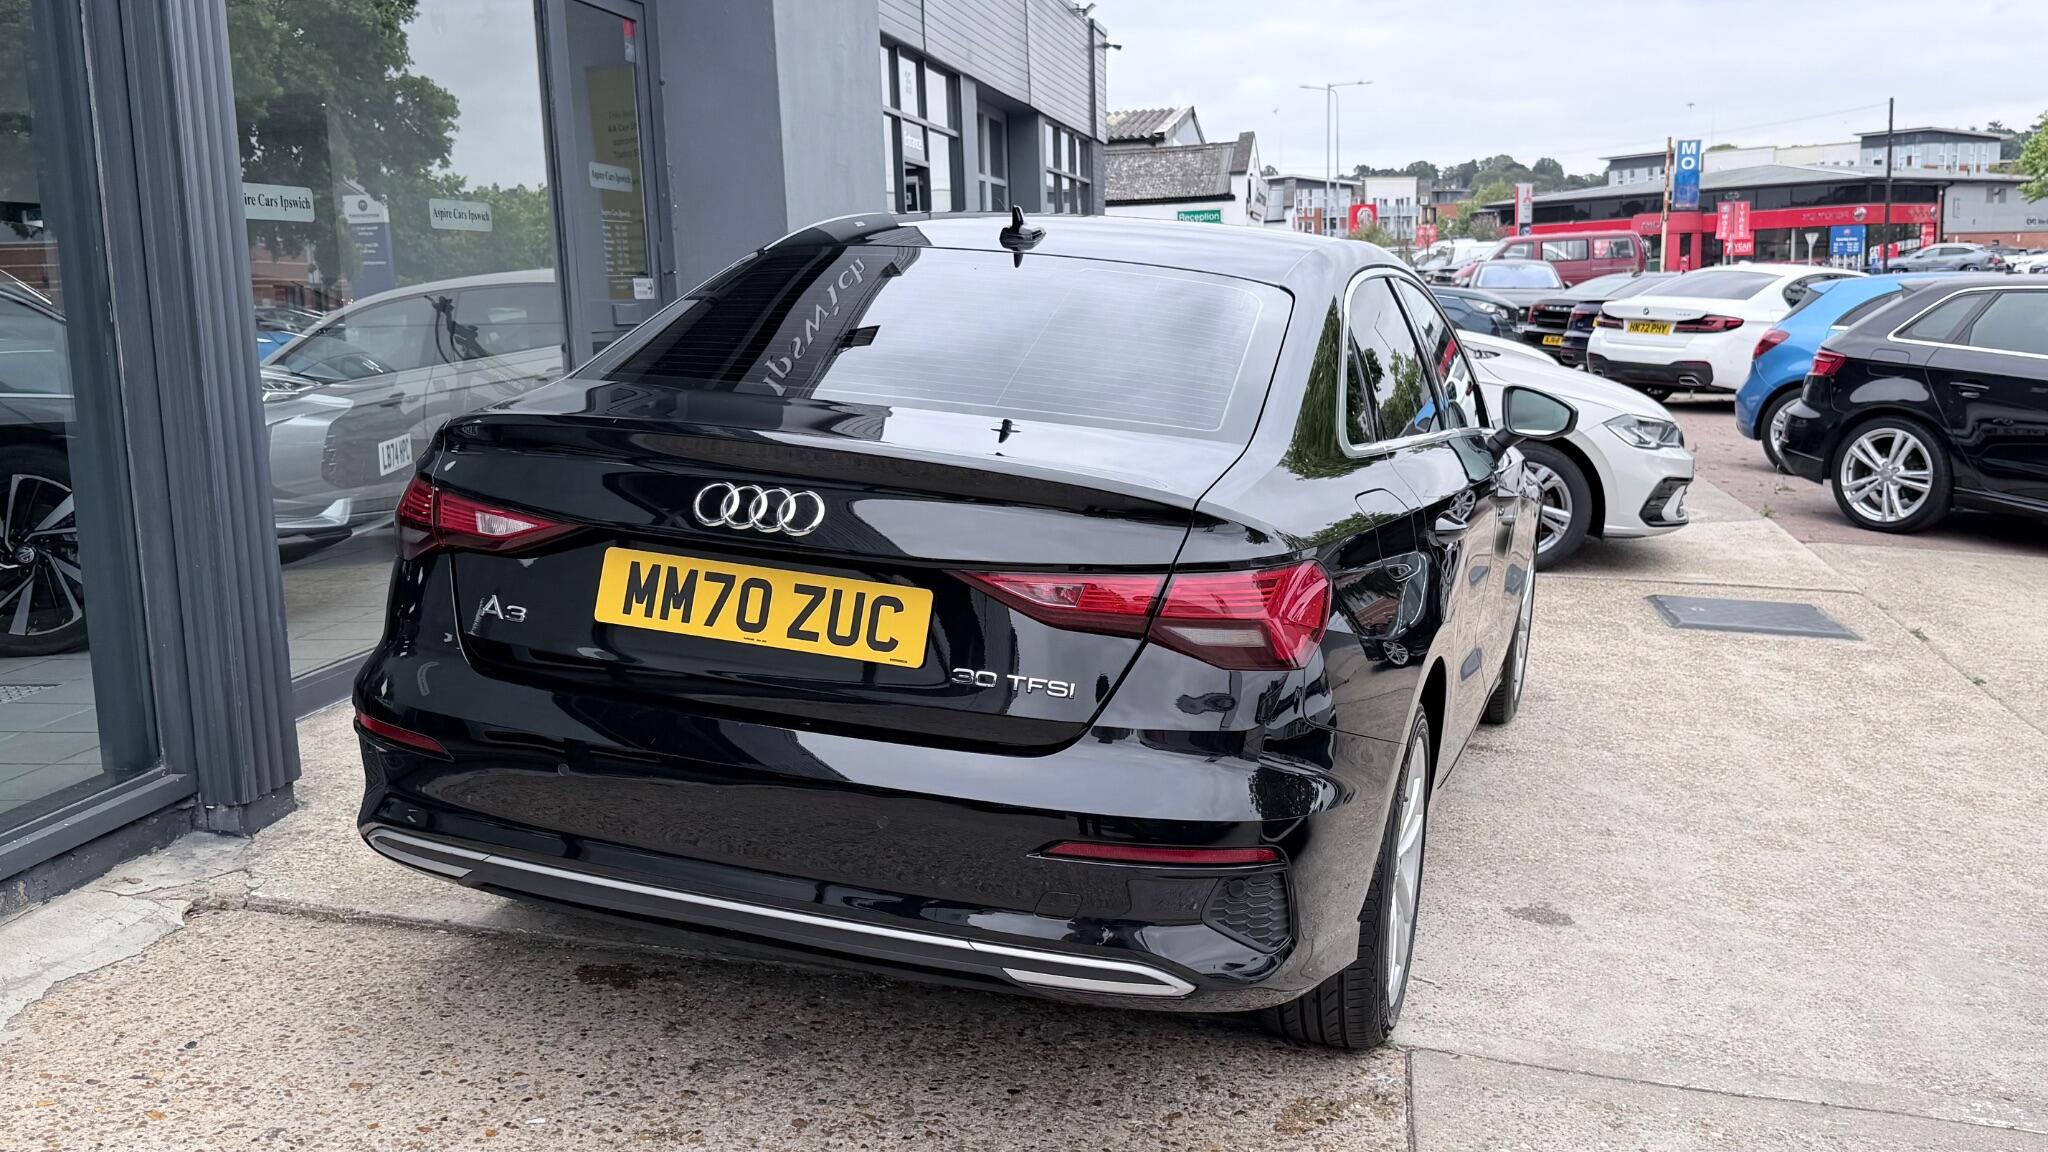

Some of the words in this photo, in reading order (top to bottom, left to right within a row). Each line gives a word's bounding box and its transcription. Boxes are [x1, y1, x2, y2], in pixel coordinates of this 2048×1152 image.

[258, 193, 278, 207] Cars
[280, 195, 311, 211] Ipswich
[433, 207, 452, 220] Aspire
[453, 208, 467, 220] Cars
[468, 209, 490, 223] Ipswich
[1179, 212, 1220, 221] Reception
[481, 594, 527, 622] A3
[622, 560, 773, 633] MM70
[786, 583, 904, 652] ZUC
[952, 667, 997, 688] 30
[1006, 674, 1076, 699] TFSI
